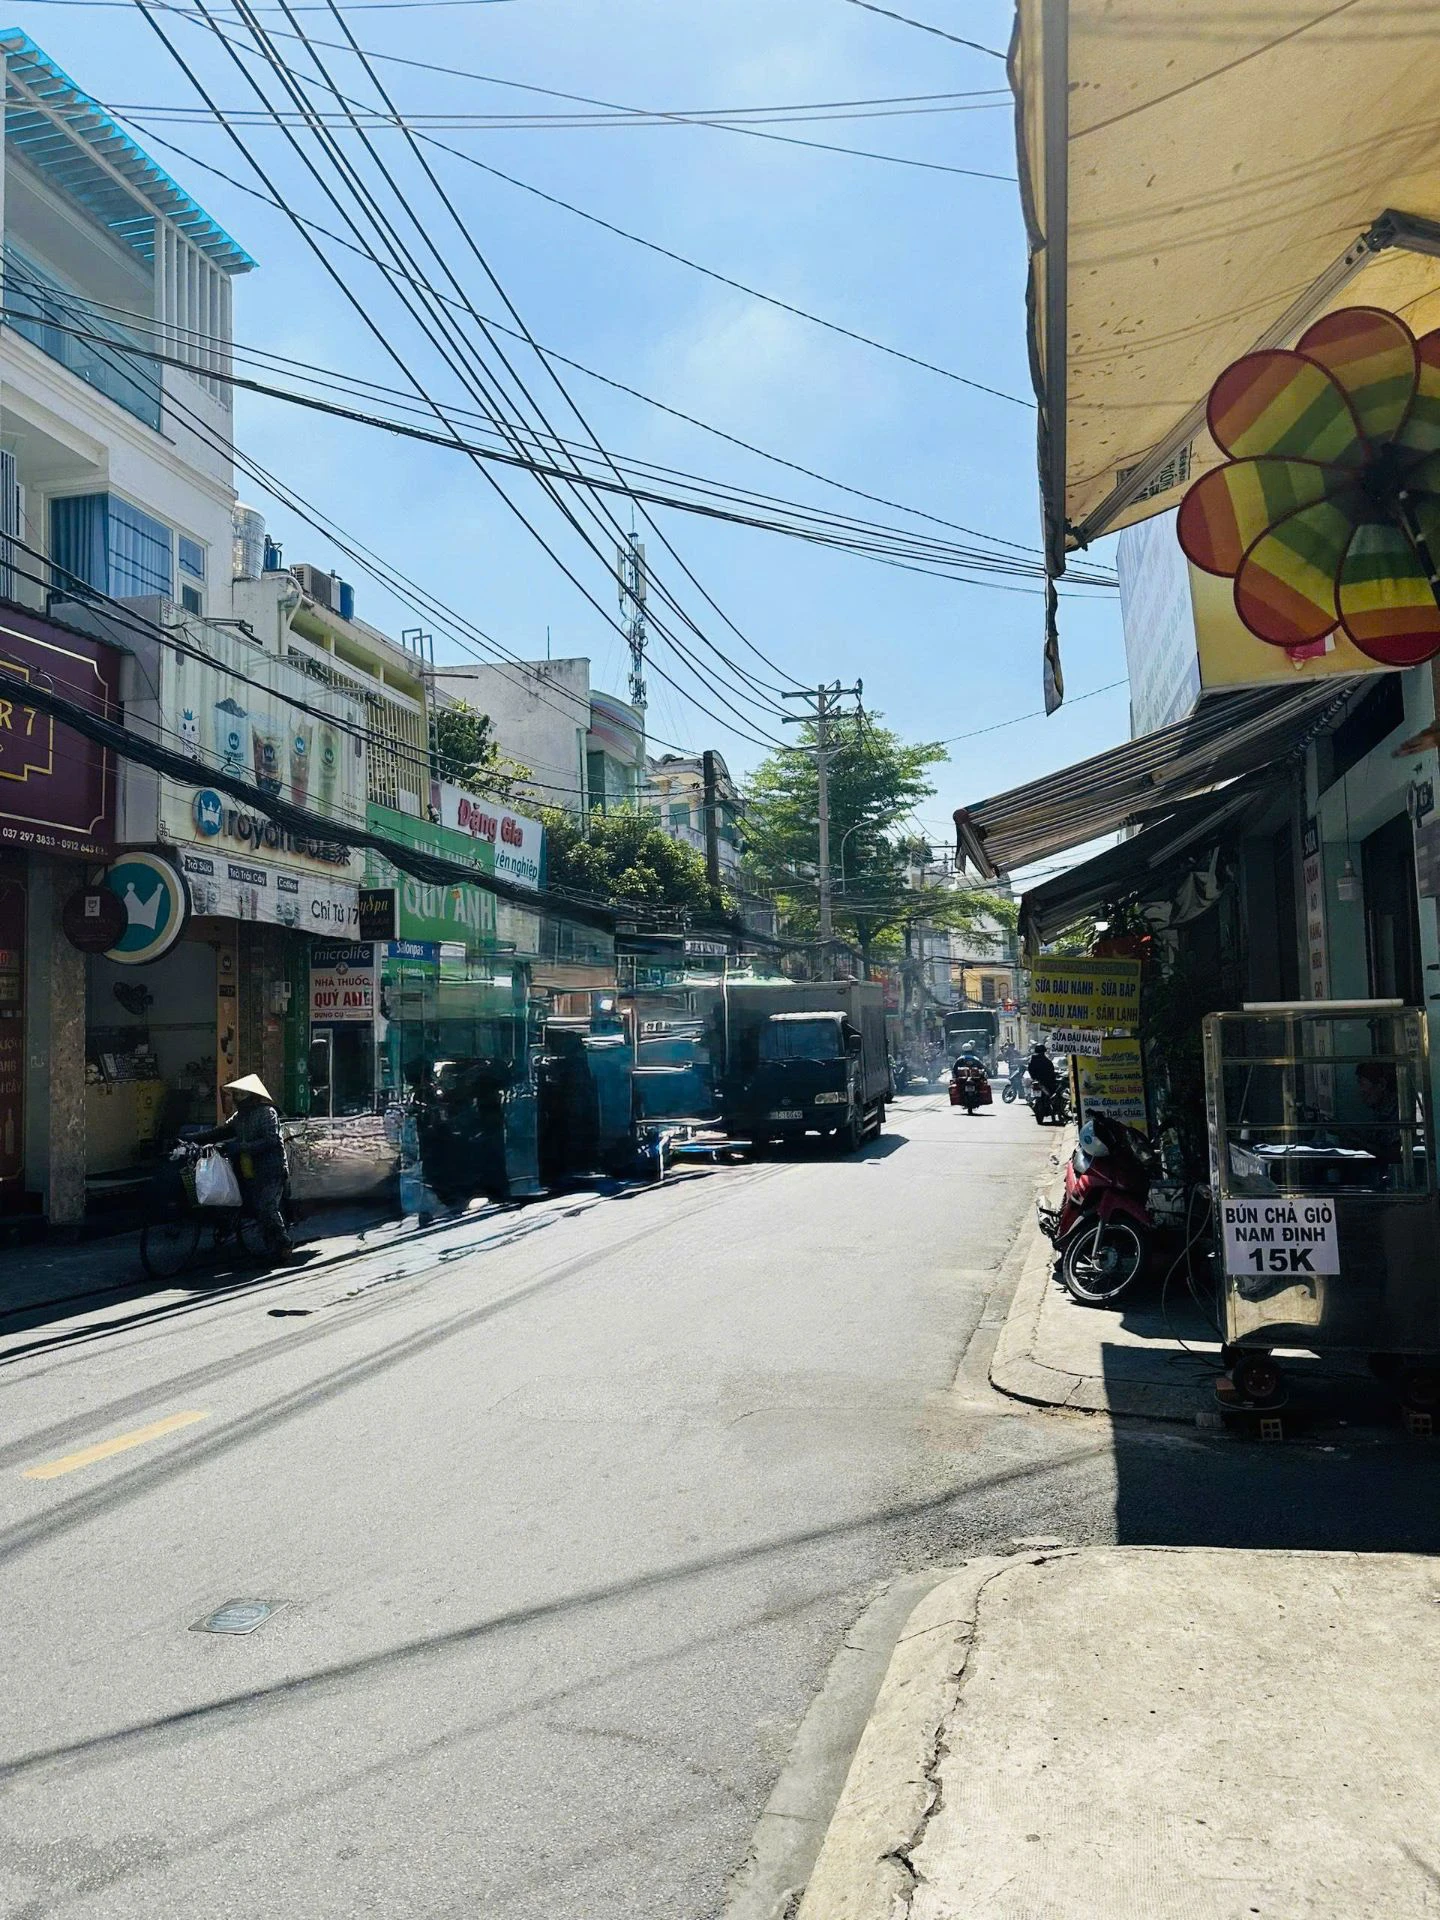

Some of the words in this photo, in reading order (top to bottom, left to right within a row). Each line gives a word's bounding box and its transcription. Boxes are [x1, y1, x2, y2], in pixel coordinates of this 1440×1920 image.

[23, 708, 37, 736] 7
[458, 798, 497, 844] Đặng
[501, 816, 523, 848] Gia
[3, 827, 17, 839] 037
[20, 831, 35, 842] 297
[36, 834, 55, 846] 3833
[61, 838, 78, 851] 0912
[311, 900, 330, 920] Chỉ
[314, 946, 370, 961] microlife
[315, 989, 339, 1008] QUÝ
[1068, 1005, 1088, 1019] XANH
[1225, 1203, 1258, 1223] BÚN
[1265, 1202, 1297, 1223] CHẢ
[1304, 1202, 1332, 1223] GIÒ
[1235, 1227, 1275, 1242] NAM
[1282, 1227, 1326, 1246] ĐỊNH
[1249, 1248, 1315, 1272] 15K
